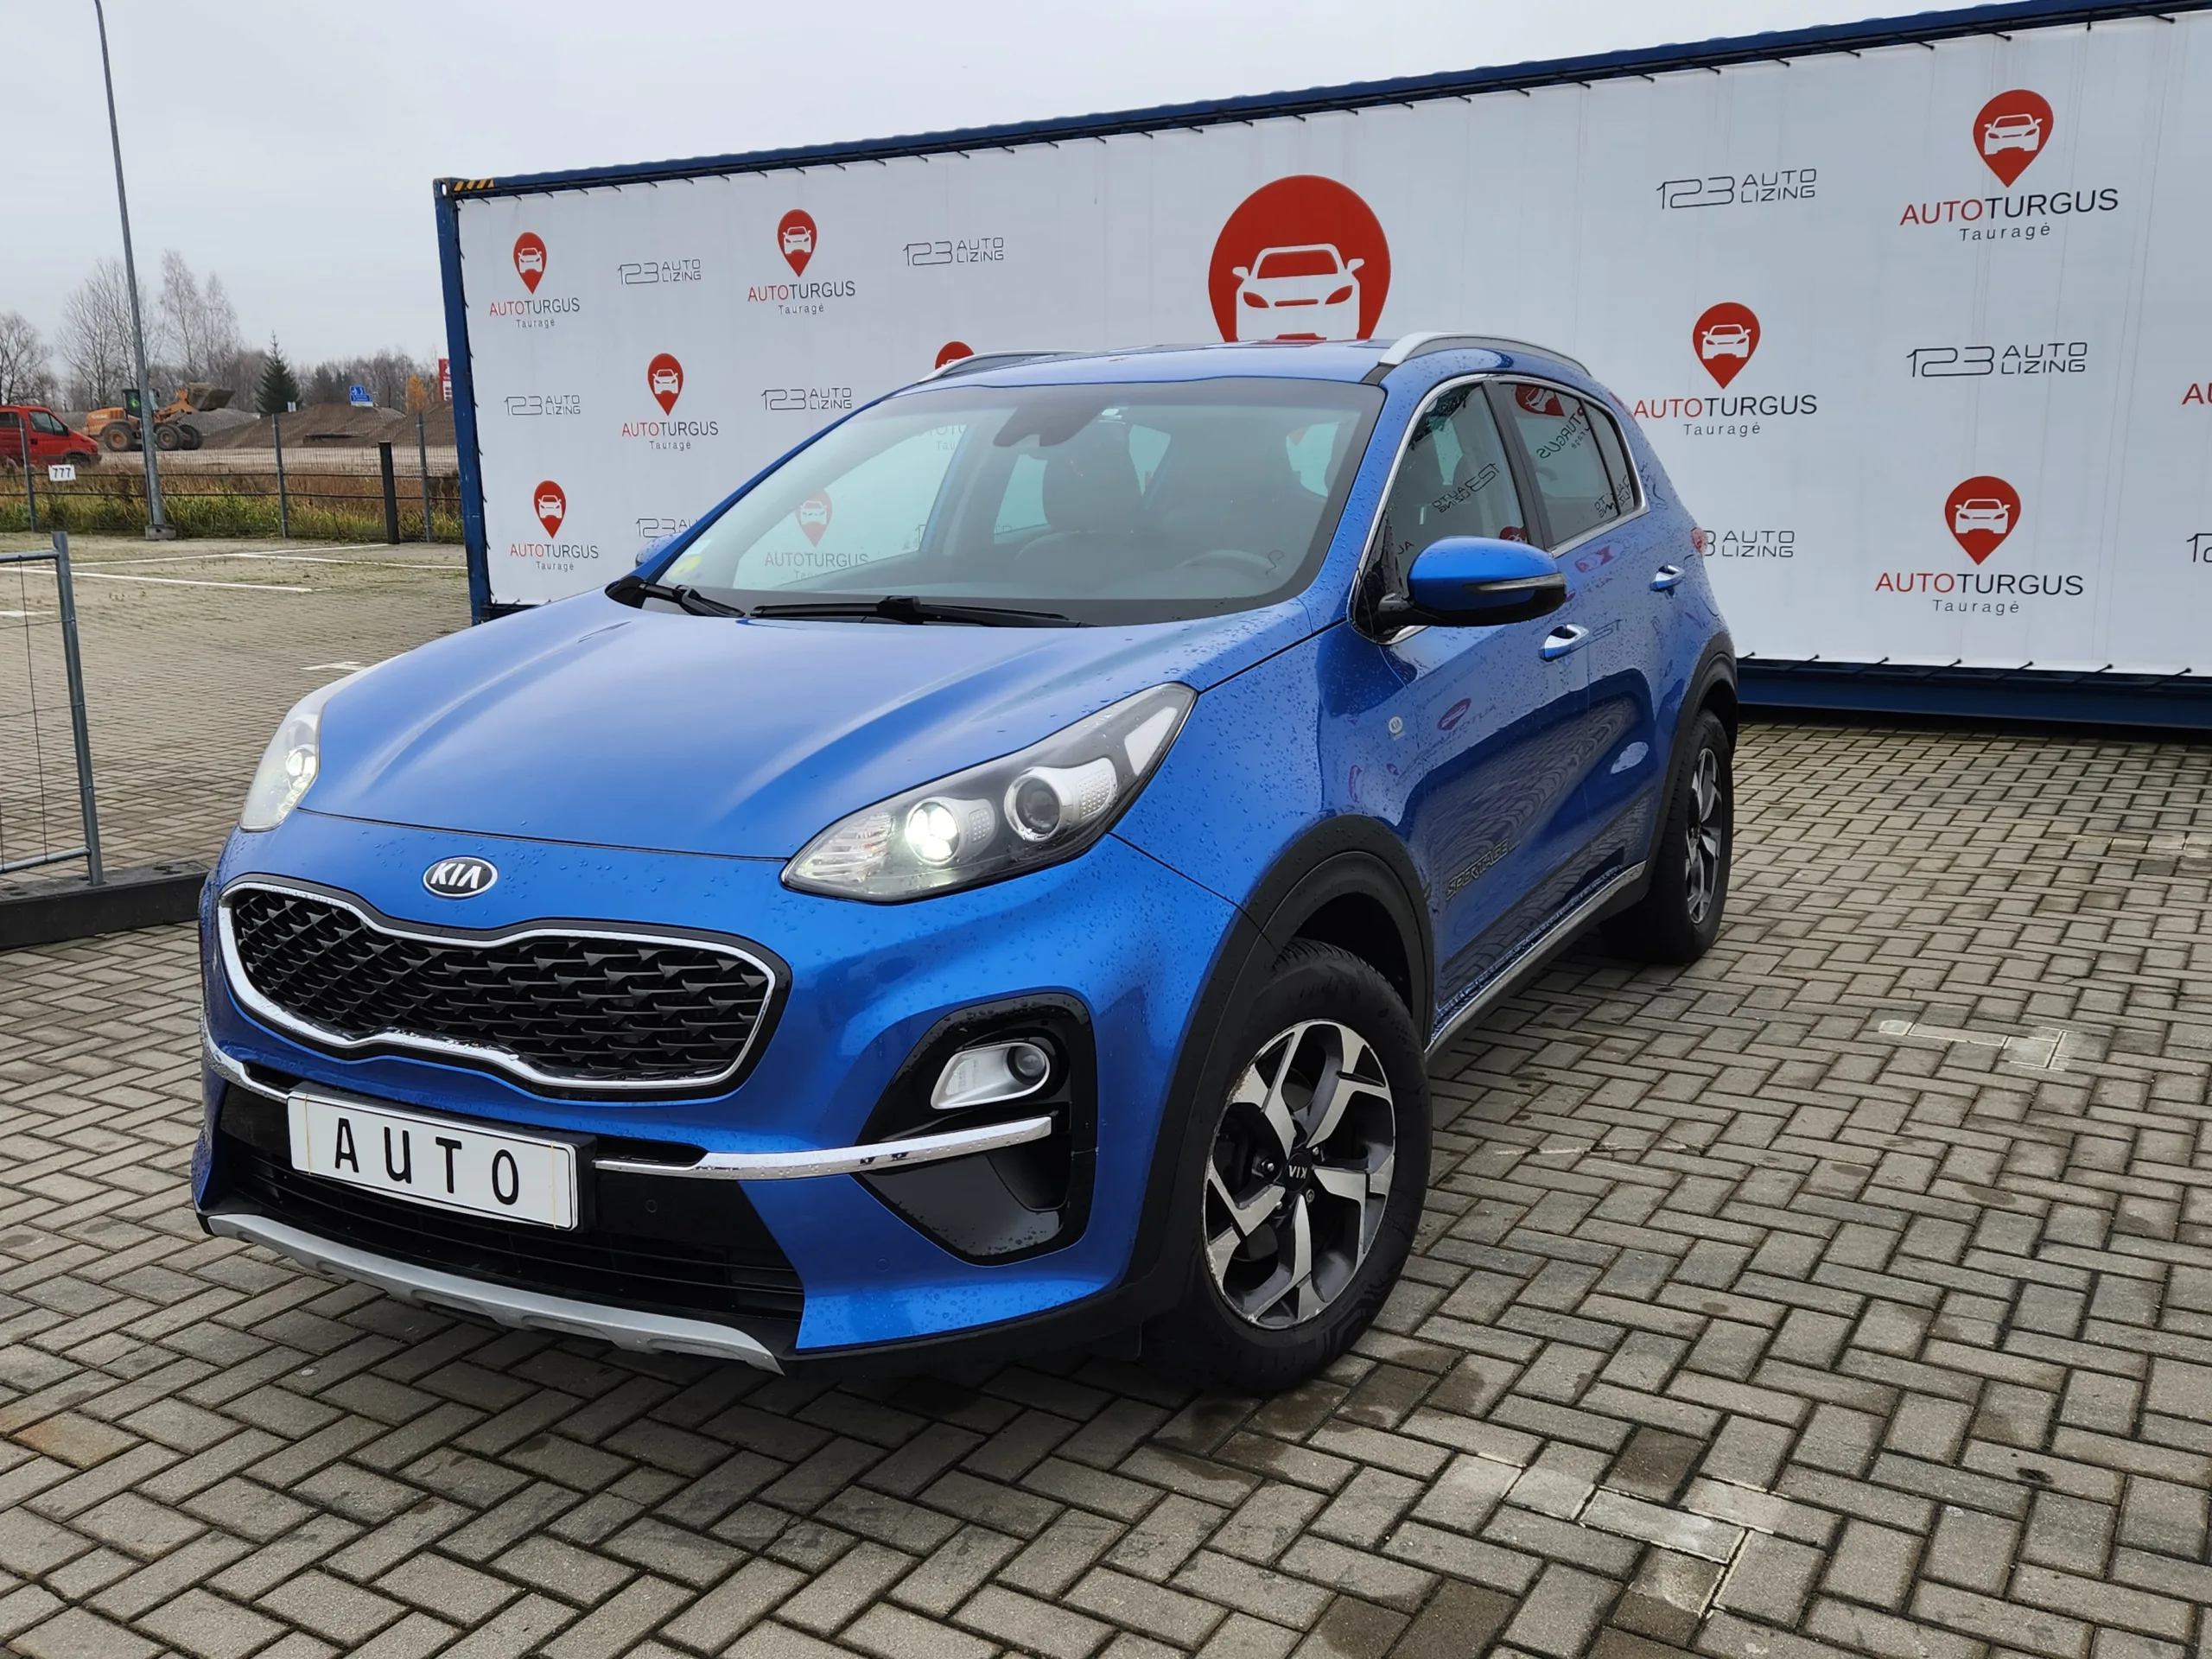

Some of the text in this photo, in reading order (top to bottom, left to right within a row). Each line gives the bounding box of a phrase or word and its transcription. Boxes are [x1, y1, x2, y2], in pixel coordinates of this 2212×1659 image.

[1656, 168, 1817, 210] 123 AUTO
[1740, 185, 1815, 203] LIZING
[1899, 188, 2119, 226] AUTOTURGUS
[1959, 222, 2050, 242] Tauragė
[902, 237, 1004, 266] 123 AUTO
[957, 249, 1004, 264] LIZING
[618, 258, 701, 285] 123 AUTO
[662, 269, 702, 283] LIZING
[747, 280, 855, 302] AUTOTURGUS
[489, 297, 581, 316] AUTOTURGUS
[778, 302, 824, 315] Tauragė
[1905, 341, 2088, 378] 123 AUTO
[2000, 359, 2086, 375] LIZING
[504, 394, 581, 416] 123 AUTO
[760, 387, 852, 410] 123 AUTO
[809, 397, 853, 410] LIZING
[1633, 394, 1818, 419] AUTOTURGUS
[545, 404, 581, 416] LIZING
[622, 421, 718, 437] AUTOTURGUS
[1683, 422, 1761, 437] Tauragė
[649, 440, 691, 452] Tauragė
[53, 467, 72, 479] 777
[1722, 530, 1796, 543] AUTO
[510, 543, 599, 560] AUTOTURGUS
[1721, 545, 1794, 558] LIZING
[1874, 572, 2084, 596] AUTOTURGUS
[1932, 599, 2020, 616] Tauragė
[429, 862, 484, 891] KIA
[334, 1116, 519, 1206] AUTO
[1288, 1163, 1307, 1179] KIA
